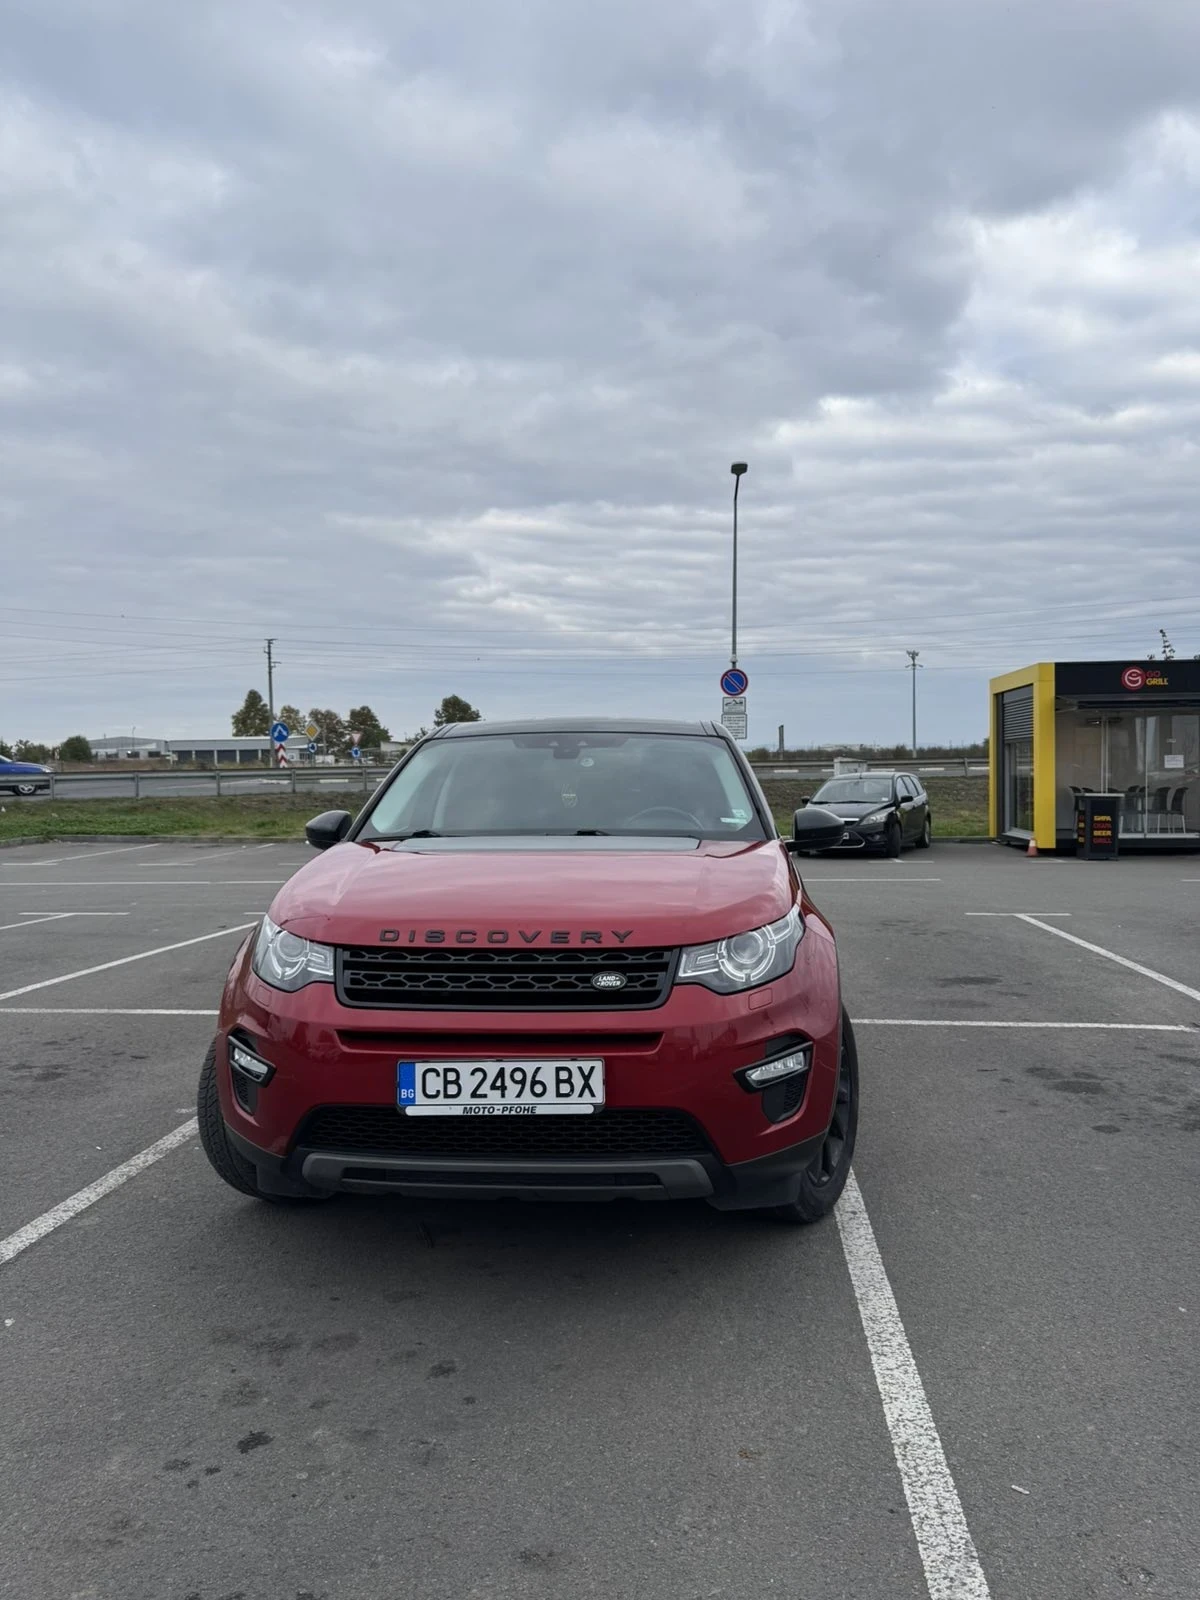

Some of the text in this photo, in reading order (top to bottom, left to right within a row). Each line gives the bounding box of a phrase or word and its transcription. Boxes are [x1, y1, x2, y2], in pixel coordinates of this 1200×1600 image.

[1146, 678, 1169, 686] GRILL
[379, 929, 634, 944] DISCOVERY
[421, 1065, 597, 1099] CB 2496 BX
[400, 1088, 414, 1098] BG
[462, 1105, 538, 1115] MOTO-PFOHE
